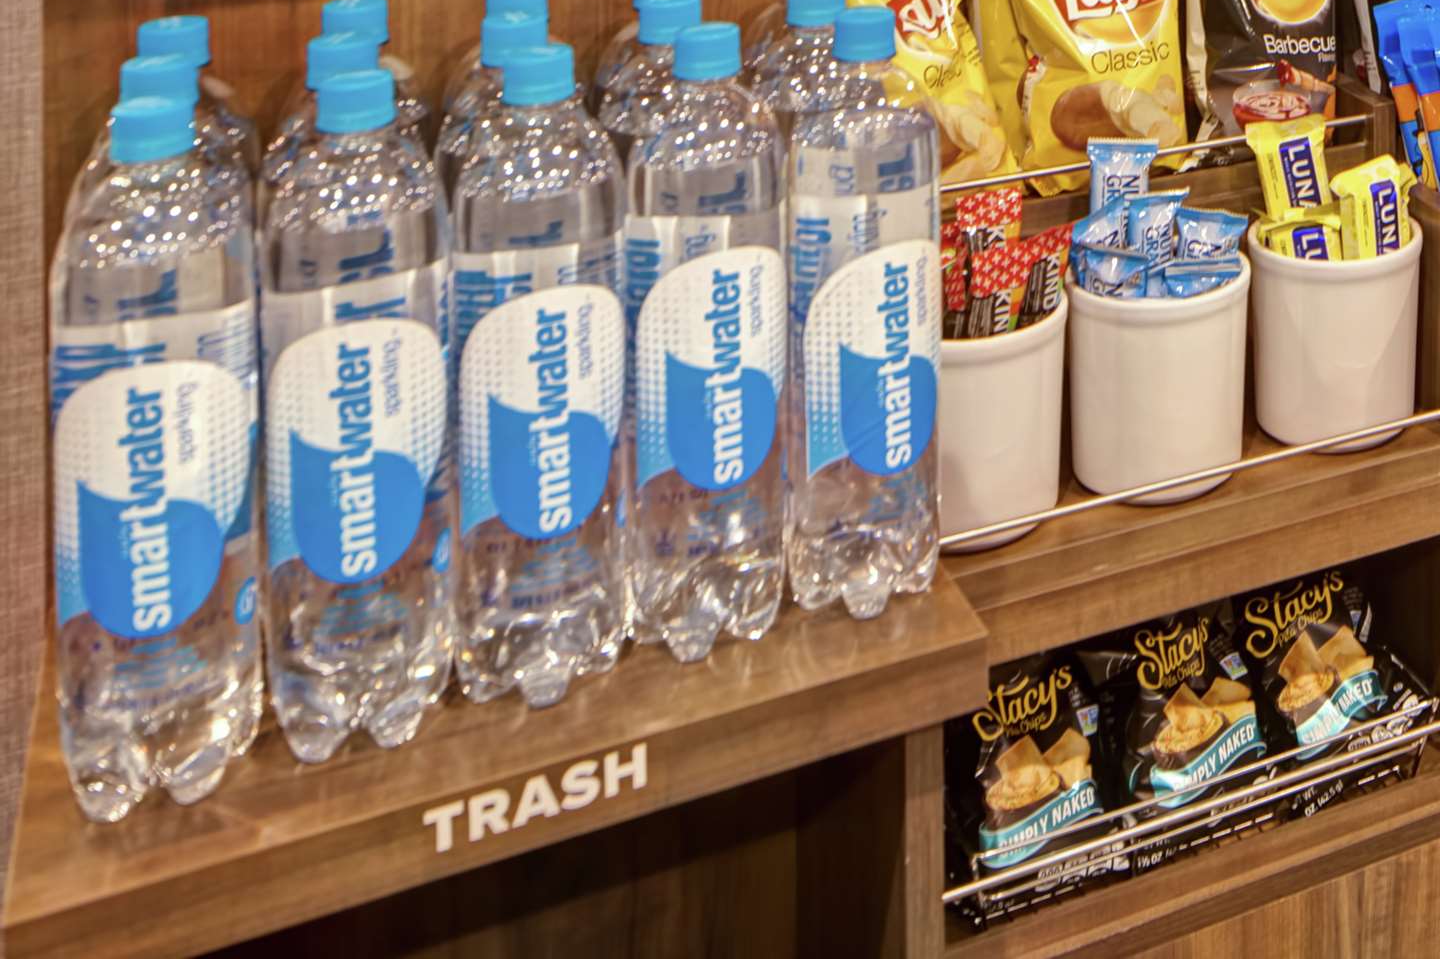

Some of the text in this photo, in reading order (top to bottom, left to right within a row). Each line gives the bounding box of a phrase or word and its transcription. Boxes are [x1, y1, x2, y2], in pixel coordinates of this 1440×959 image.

[1090, 41, 1170, 76] Classic
[1263, 33, 1337, 55] Barbecue
[1043, 253, 1060, 311] KIND
[704, 268, 744, 488] smartwater
[877, 261, 911, 470] smartwater
[528, 308, 572, 534] smartwater
[328, 343, 379, 579] smartwater
[119, 385, 173, 633] smartwater
[1244, 571, 1344, 659] Stacy's
[1297, 609, 1324, 631] Chips
[972, 665, 1073, 742] Stacy's
[1019, 712, 1048, 736] Chips
[1219, 722, 1256, 765] NAKED
[422, 742, 648, 853] TRASH
[1052, 786, 1096, 827] NAKED
